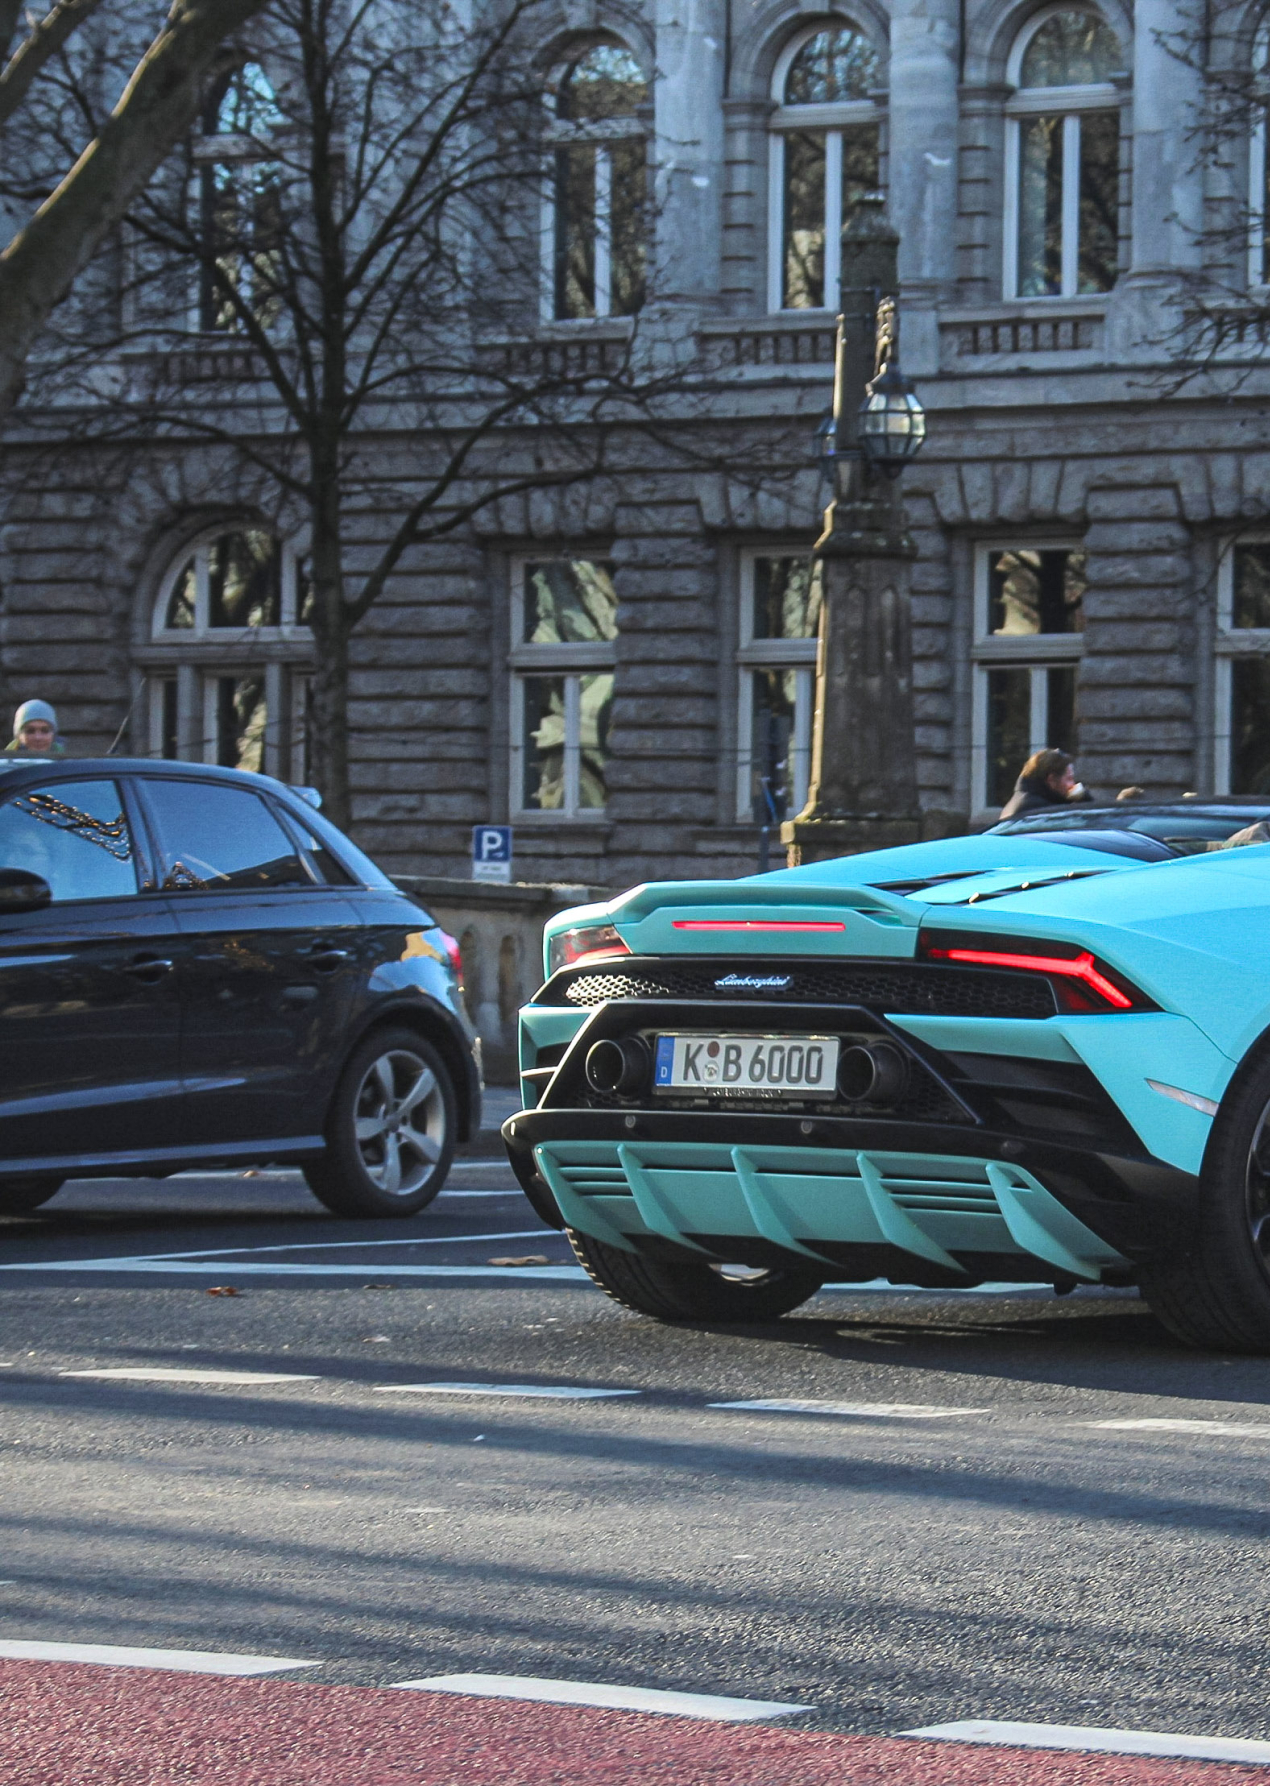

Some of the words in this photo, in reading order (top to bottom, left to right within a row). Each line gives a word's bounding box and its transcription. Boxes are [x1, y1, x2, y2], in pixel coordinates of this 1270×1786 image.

[482, 831, 502, 859] P
[660, 1066, 668, 1078] D
[682, 1043, 704, 1081] K
[722, 1044, 742, 1082] B
[748, 1045, 823, 1084] 6000
